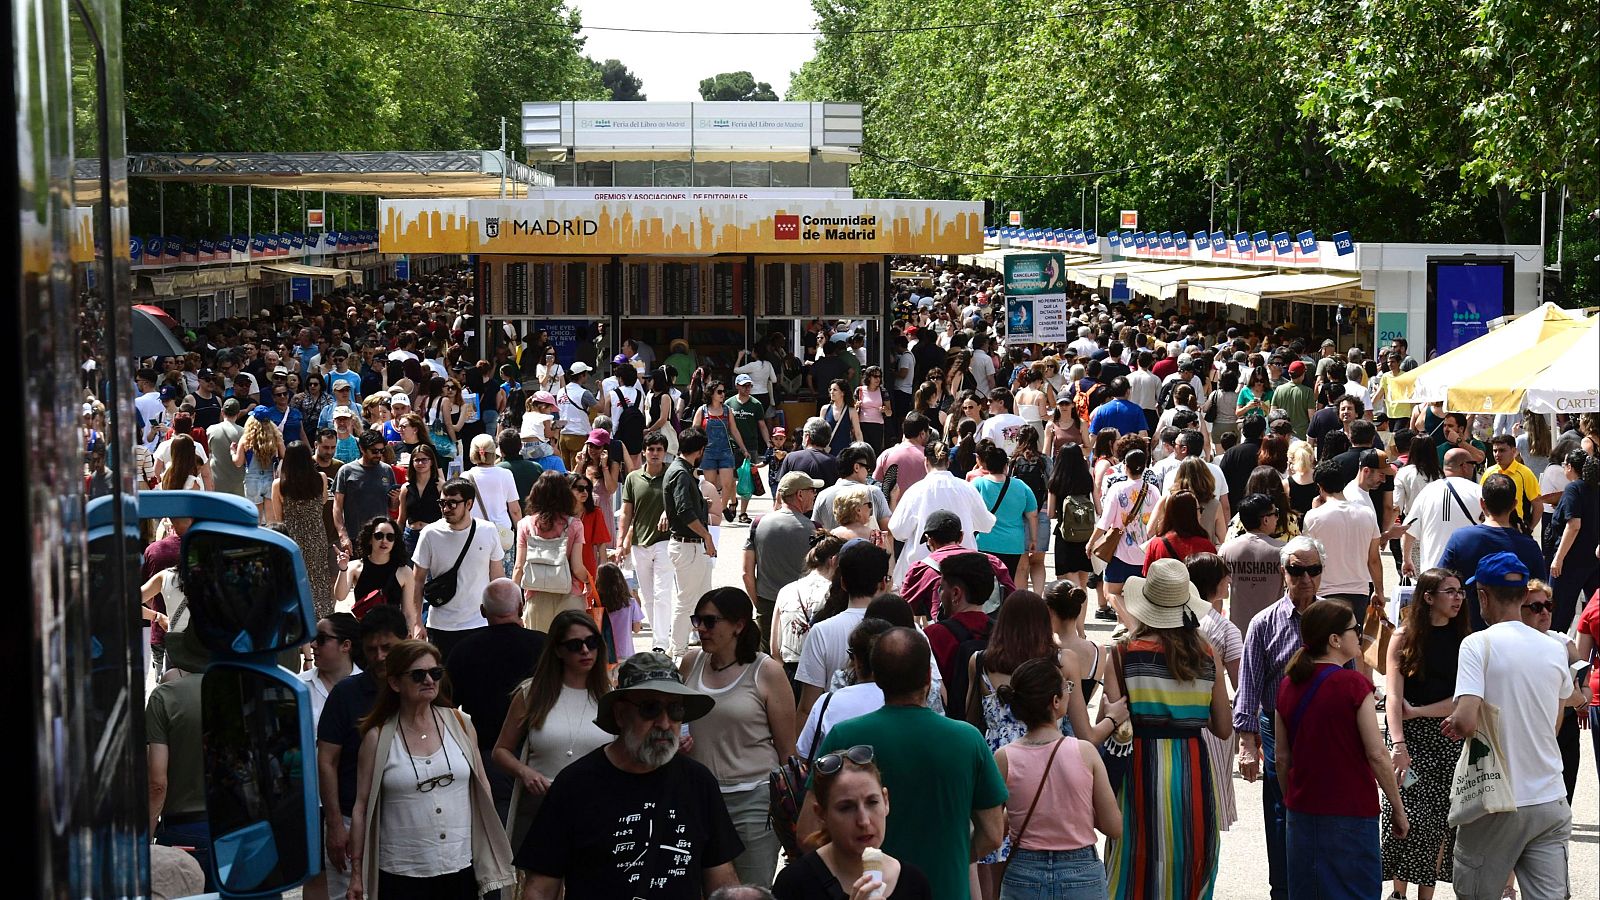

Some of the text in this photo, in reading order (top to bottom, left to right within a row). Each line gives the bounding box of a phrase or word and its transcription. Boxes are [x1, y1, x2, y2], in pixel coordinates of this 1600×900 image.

[613, 120, 628, 128] Feria
[629, 120, 639, 128] del
[640, 120, 657, 128] Libro
[658, 120, 665, 128] de
[666, 120, 685, 128] Madrid
[731, 120, 747, 128] Feria
[747, 120, 757, 128] del
[758, 120, 775, 128] Libro
[776, 120, 783, 128] de
[784, 120, 803, 128] Madrid
[802, 215, 875, 226] Comunidad
[513, 219, 598, 235] MADRID
[802, 229, 875, 240] de Madrid
[1110, 235, 1118, 243] 139
[1135, 236, 1144, 244] 137
[1148, 236, 1158, 244] 136
[1162, 236, 1172, 245] 135
[1176, 237, 1187, 246] 134
[1196, 237, 1207, 245] 133
[1213, 237, 1224, 246] 132
[1237, 238, 1248, 247] 131
[1256, 238, 1268, 248] 130
[1276, 239, 1288, 249] 129
[1300, 237, 1313, 248] 128
[1336, 239, 1350, 250] 128
[1380, 331, 1403, 340] 20A
[1556, 397, 1596, 411] CARTE
[1226, 561, 1280, 575] GYMSHARK
